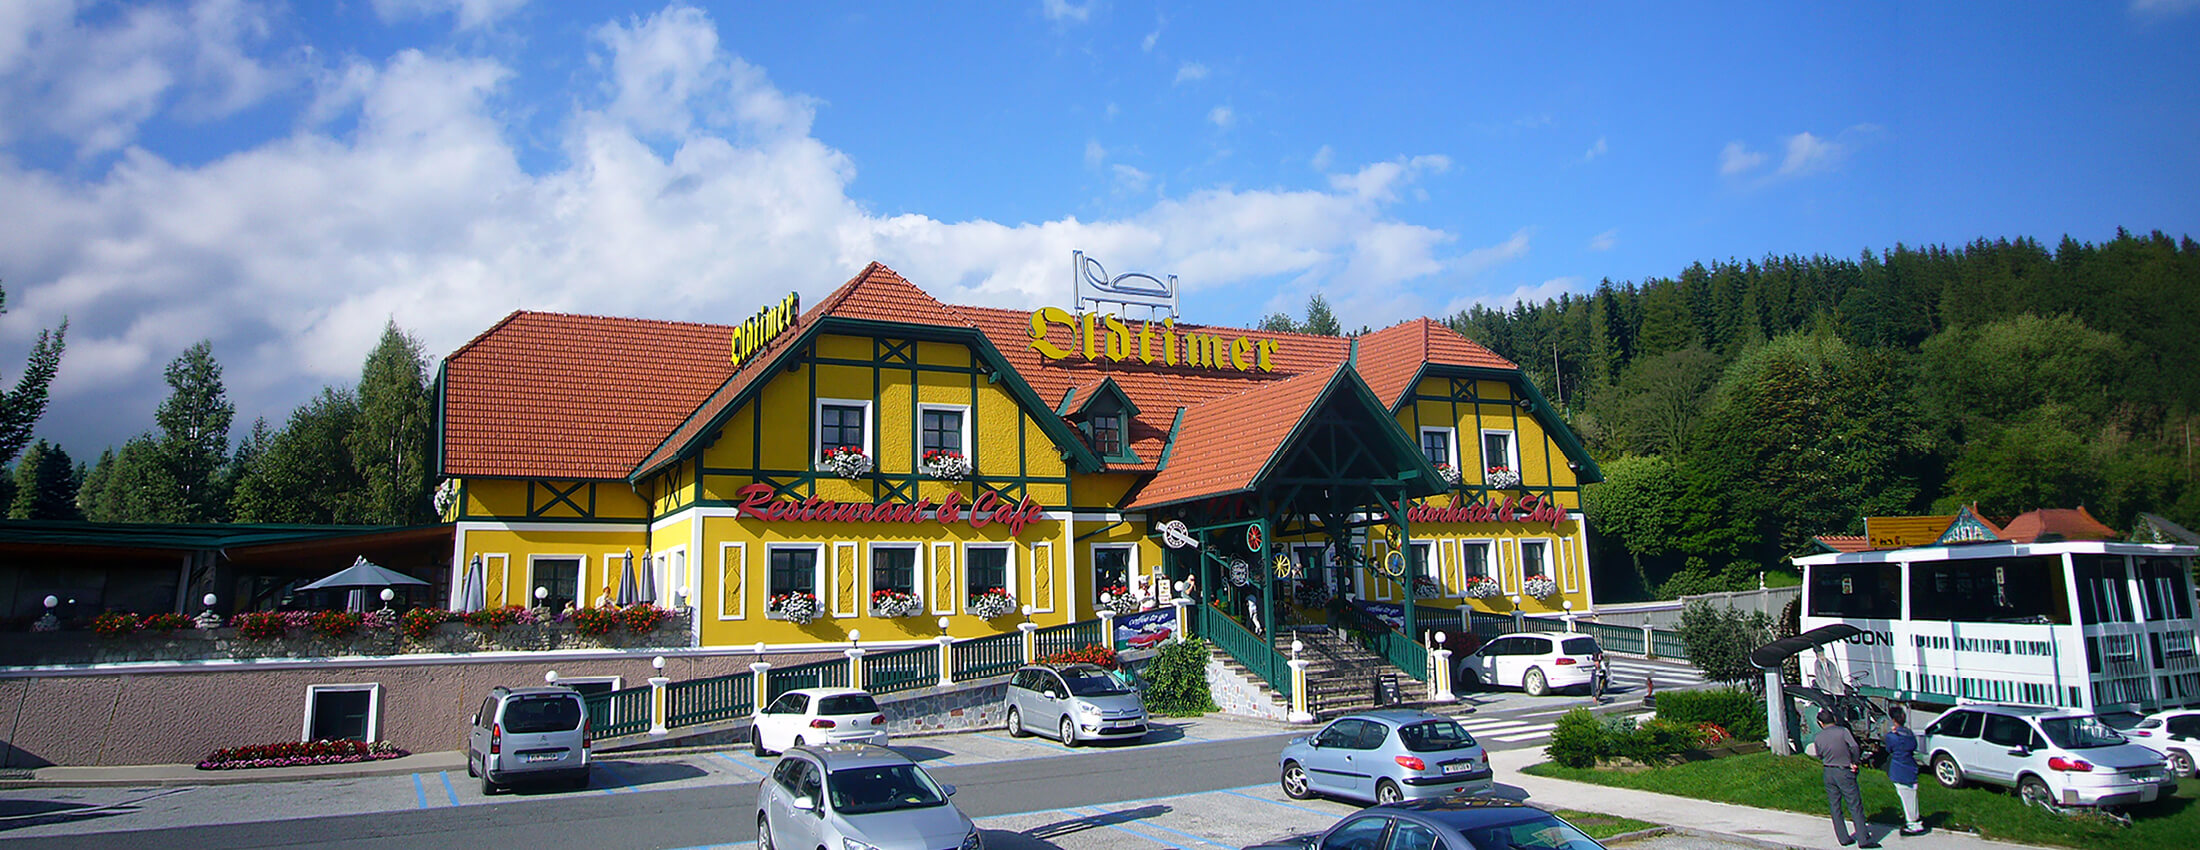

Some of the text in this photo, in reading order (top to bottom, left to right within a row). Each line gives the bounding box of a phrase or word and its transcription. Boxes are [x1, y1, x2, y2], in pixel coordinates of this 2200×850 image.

[732, 292, 799, 366] Oldtimer
[1025, 306, 1280, 373] Oldtimer
[734, 483, 931, 524] Restaurant
[935, 490, 962, 524] &
[1383, 495, 1568, 529] otorhotel & Shop
